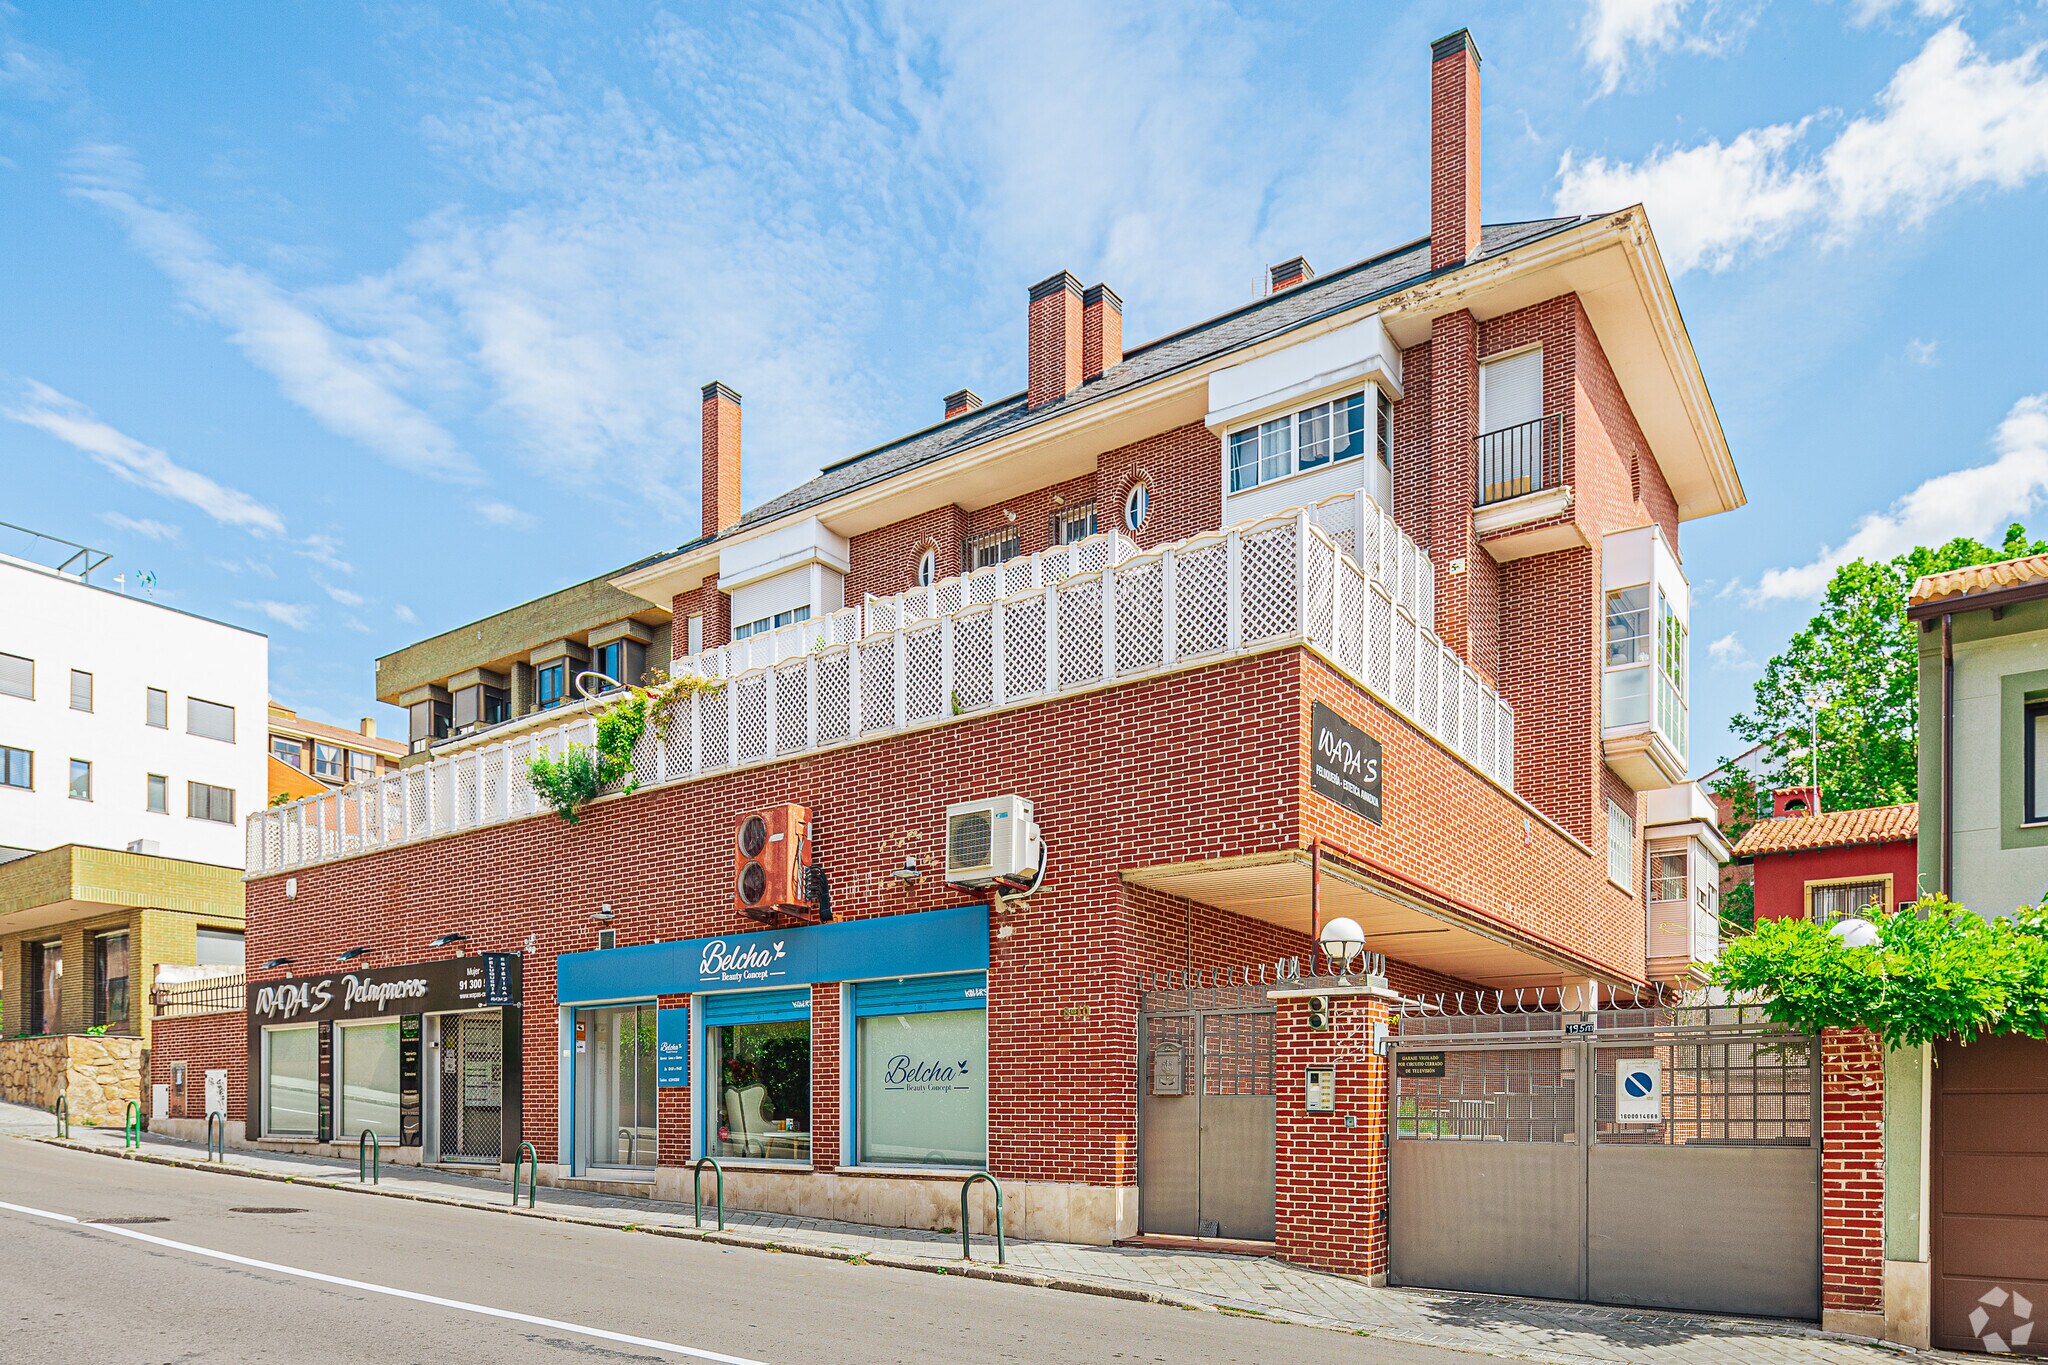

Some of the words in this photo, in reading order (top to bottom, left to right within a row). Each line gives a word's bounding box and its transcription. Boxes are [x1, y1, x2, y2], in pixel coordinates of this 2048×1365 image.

[1318, 727, 1378, 783] WAPA'S
[700, 940, 772, 974] Belcha
[459, 980, 468, 991] 91
[469, 978, 482, 989] 300
[721, 972, 742, 983] Beauty
[743, 969, 769, 981] Concept
[255, 979, 334, 1019] WAPA'S
[1063, 1005, 1090, 1019] 8-10
[884, 1054, 957, 1085] Belcha
[906, 1084, 926, 1093] Beauty
[927, 1083, 952, 1093] Concept
